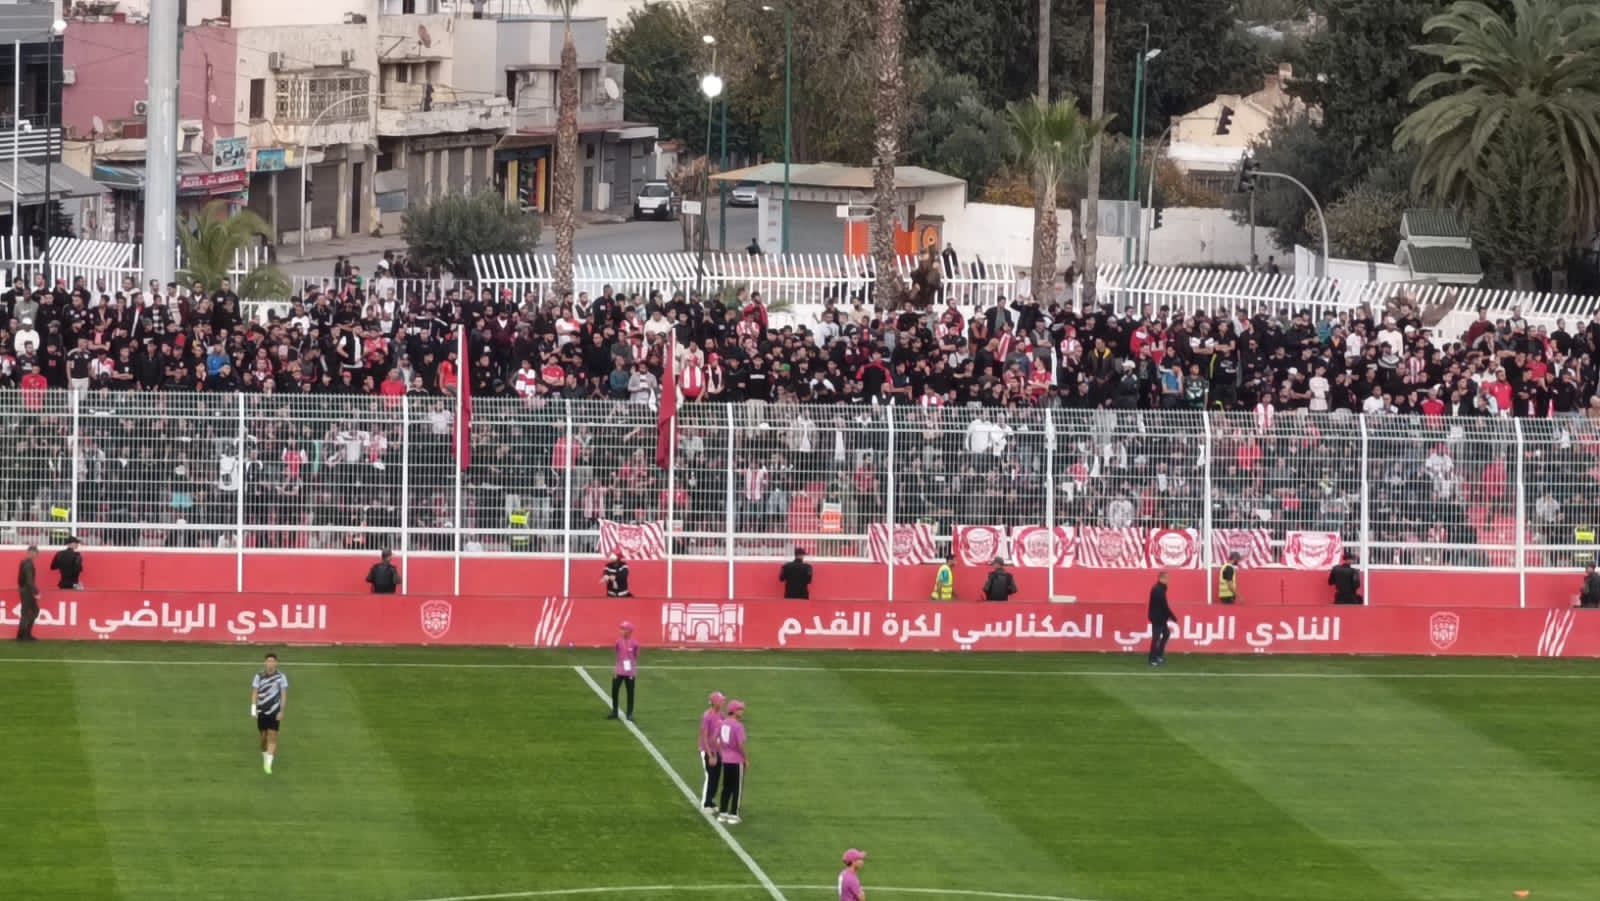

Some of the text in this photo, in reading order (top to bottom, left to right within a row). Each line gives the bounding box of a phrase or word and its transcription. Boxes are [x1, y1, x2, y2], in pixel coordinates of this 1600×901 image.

[88, 600, 217, 639] الرياضي
[227, 603, 327, 640] النادي
[777, 610, 871, 646] القدم
[881, 611, 942, 643] لكرة
[952, 612, 1104, 651] المكناسي
[1245, 616, 1341, 653] النادي
